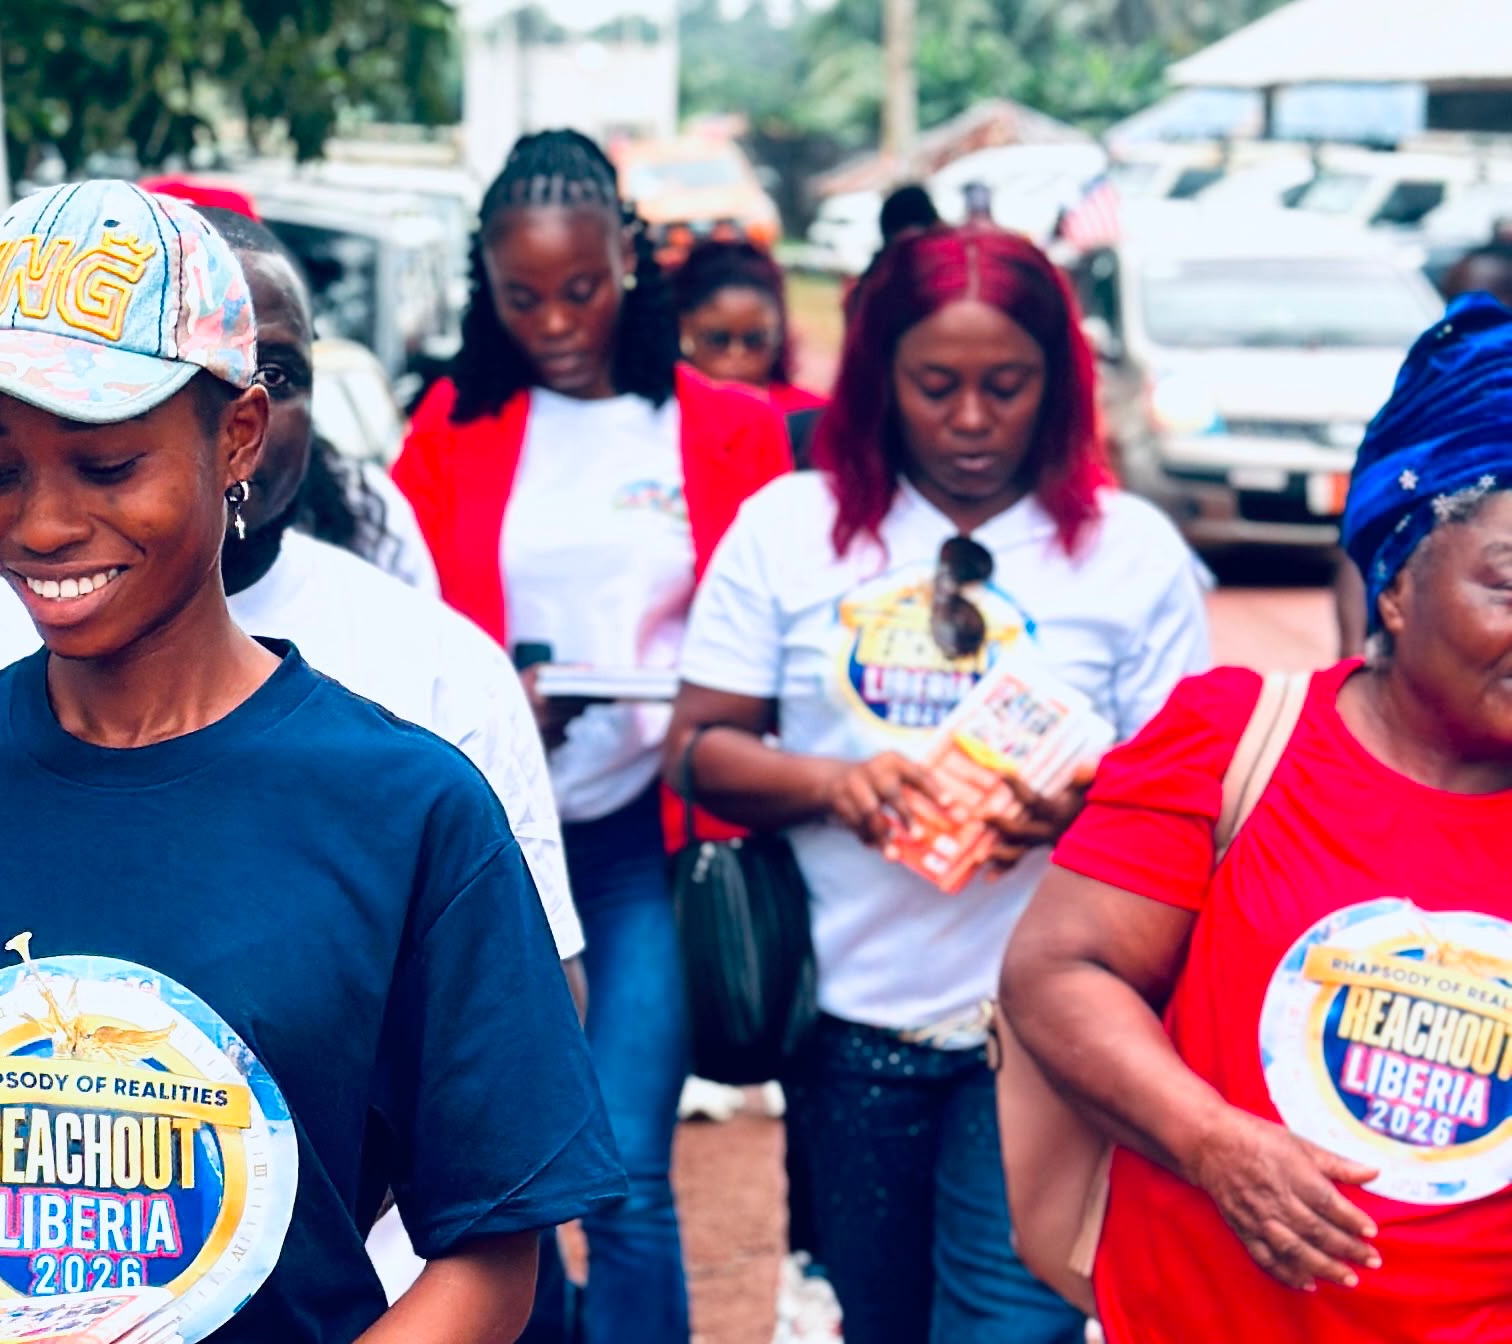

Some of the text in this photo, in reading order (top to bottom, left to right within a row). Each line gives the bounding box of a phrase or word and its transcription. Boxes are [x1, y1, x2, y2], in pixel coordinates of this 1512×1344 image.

[1331, 958, 1432, 987] RHAPSODY
[1437, 978, 1462, 993] OF
[75, 1074, 108, 1094] OF
[114, 1076, 229, 1107] REALITIES
[1345, 1047, 1486, 1124] LIBERIA
[1367, 1099, 1454, 1147] 2026
[35, 1255, 142, 1295] 2026
